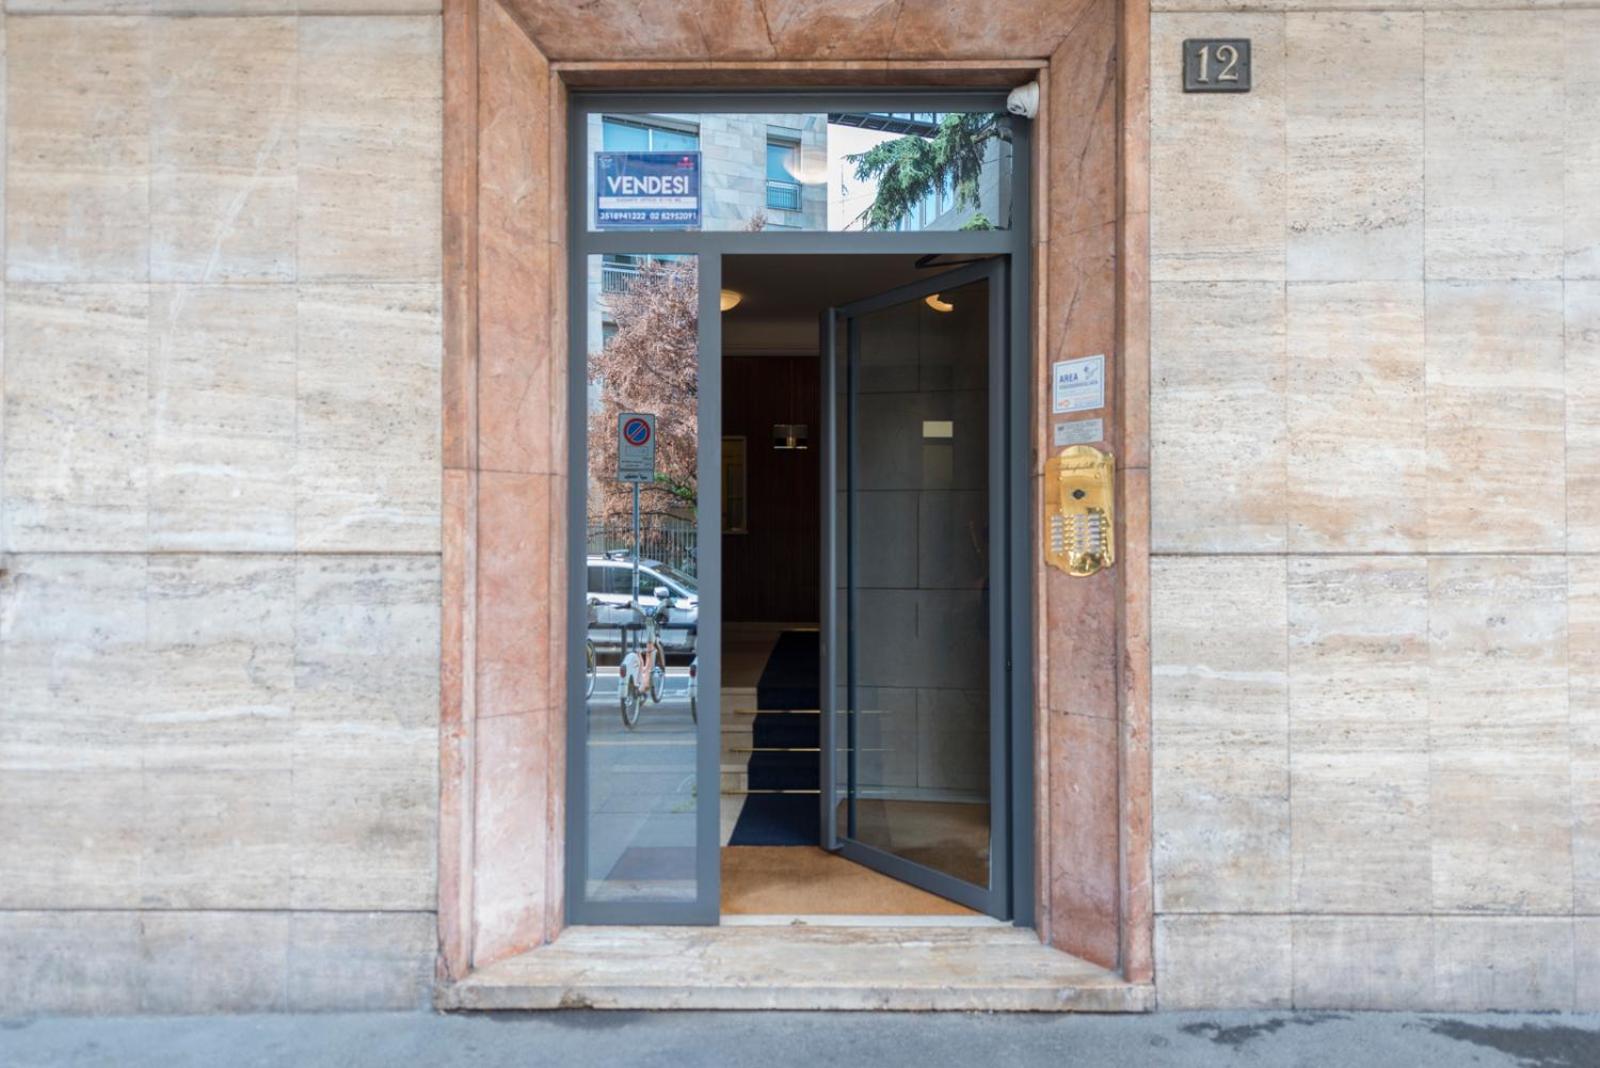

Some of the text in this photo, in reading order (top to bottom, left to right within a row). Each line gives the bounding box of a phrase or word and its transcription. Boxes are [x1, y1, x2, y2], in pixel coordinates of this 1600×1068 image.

[1198, 44, 1239, 82] 12
[607, 175, 689, 195] VENDESI
[1059, 372, 1078, 383] AREA
